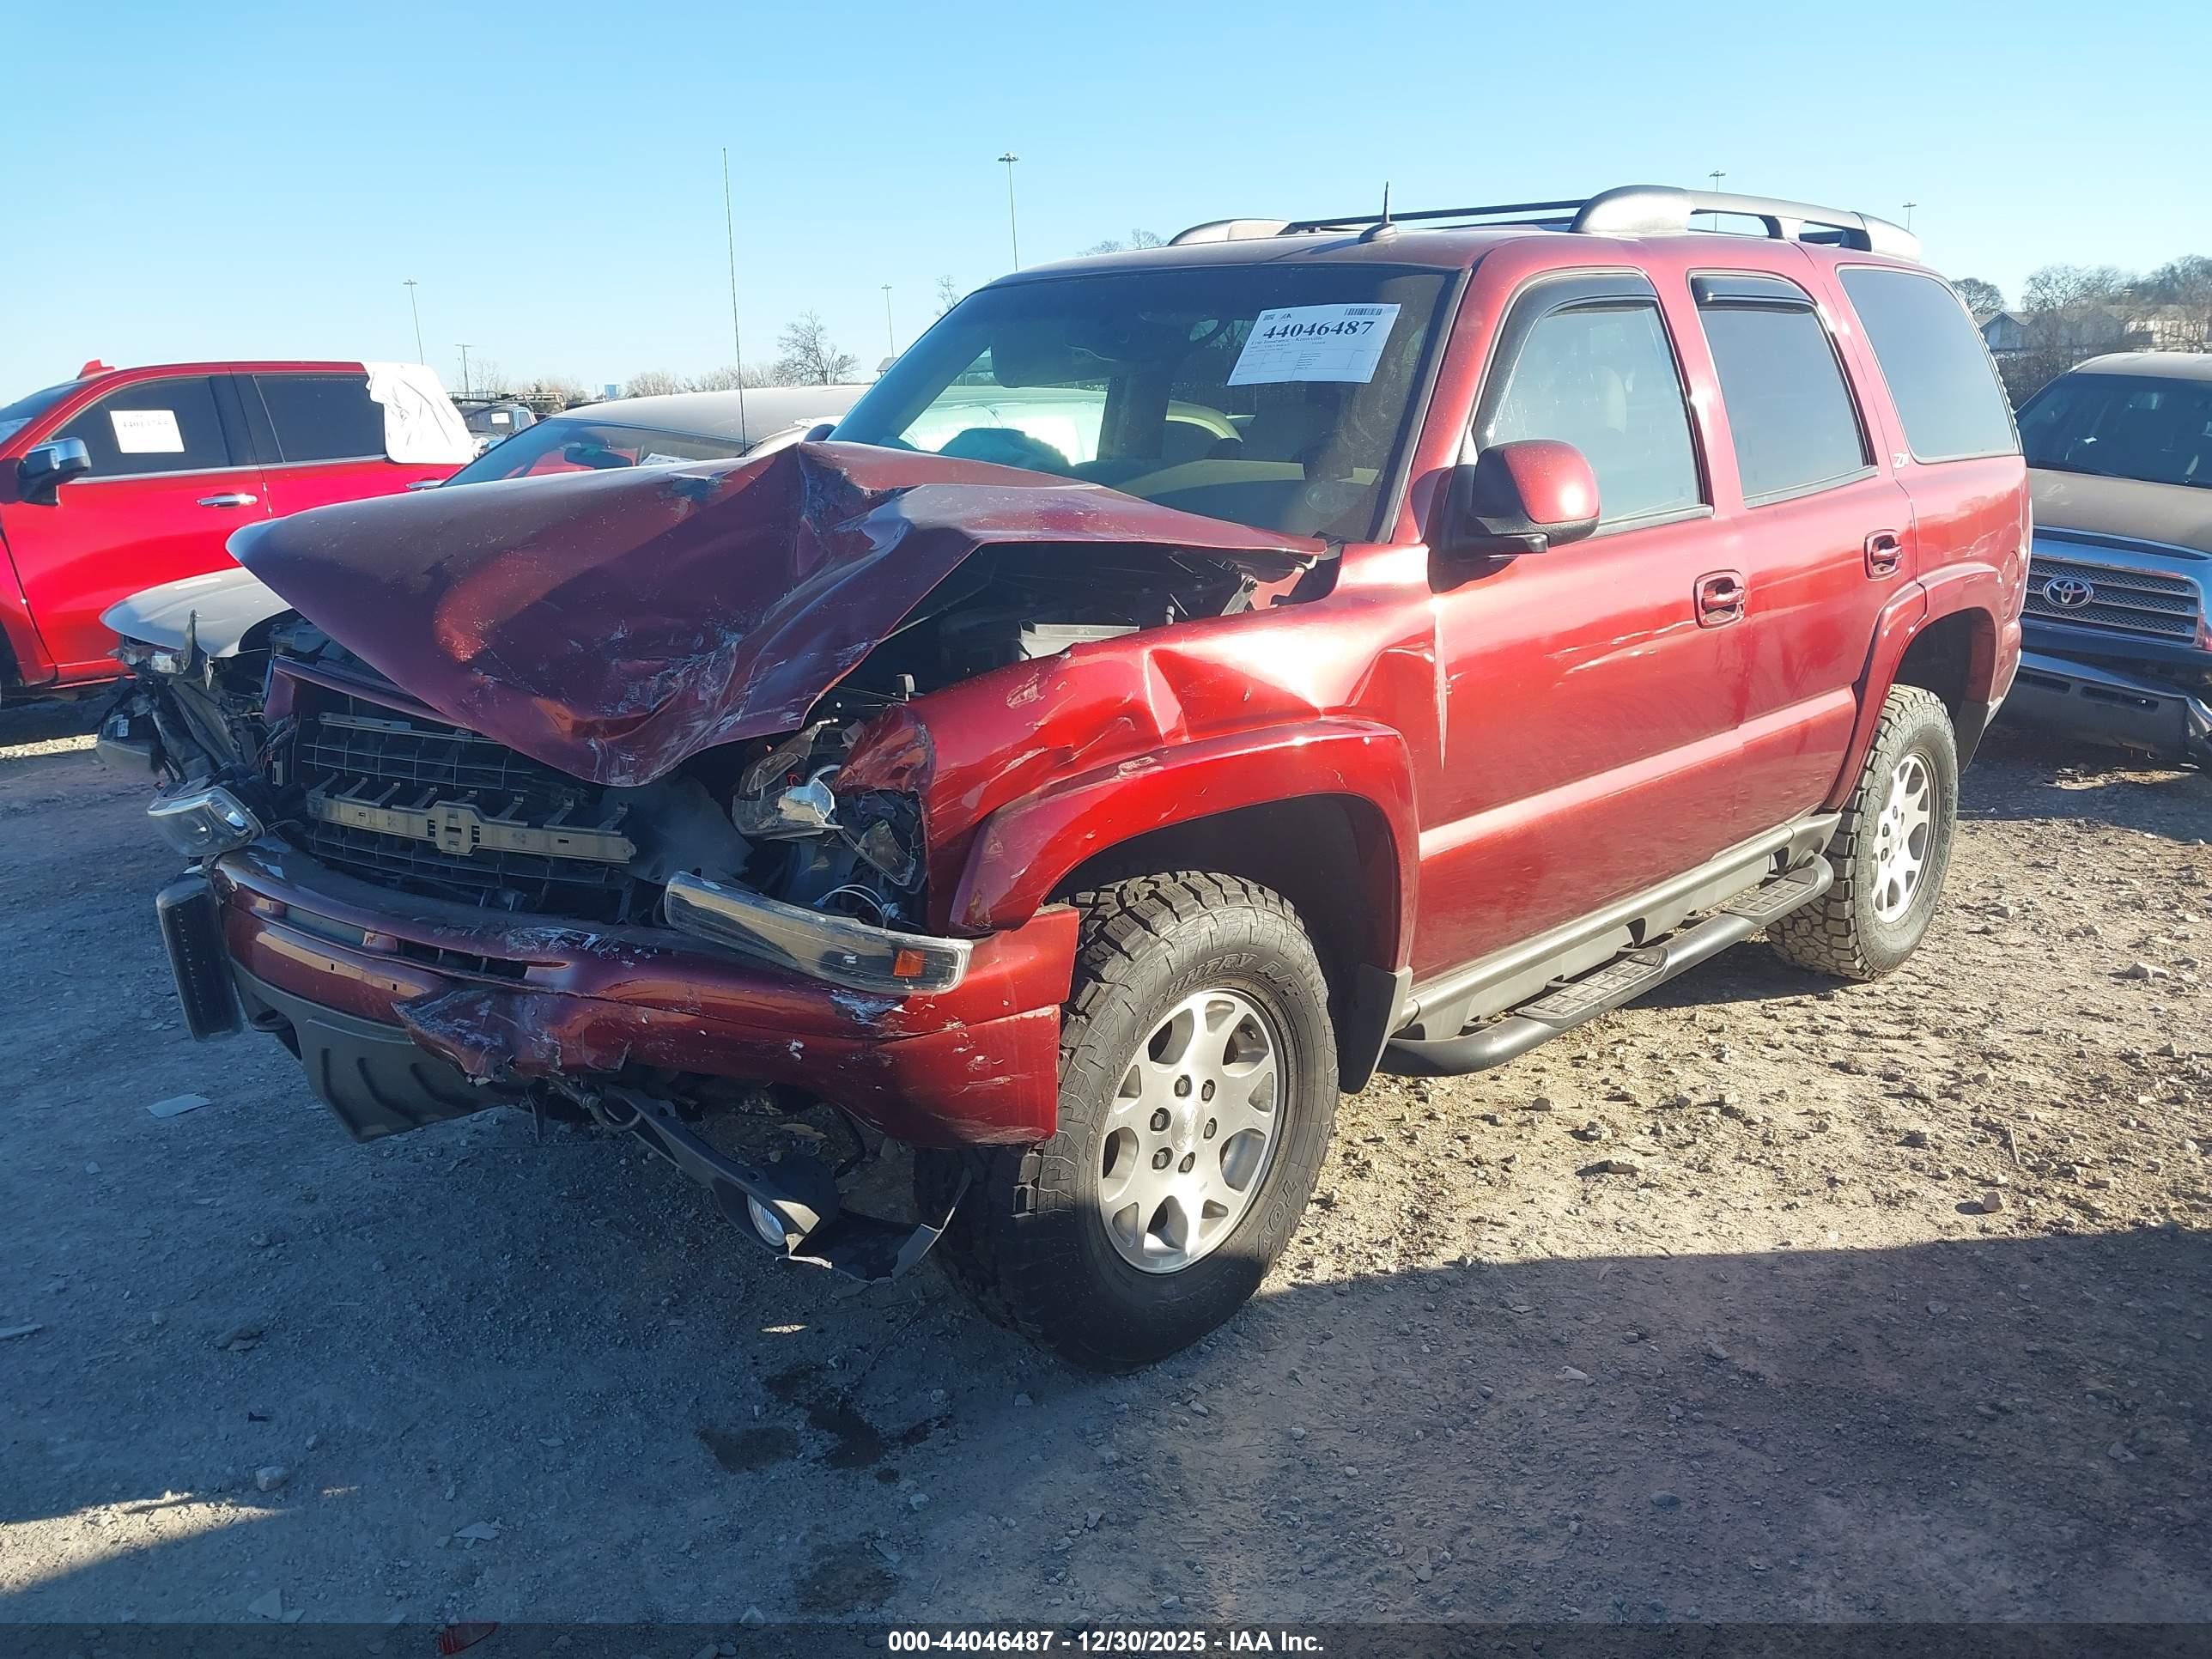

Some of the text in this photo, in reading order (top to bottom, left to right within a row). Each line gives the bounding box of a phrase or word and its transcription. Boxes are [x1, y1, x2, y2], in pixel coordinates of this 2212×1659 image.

[1263, 321, 1375, 339] 44046487
[1942, 782, 1954, 846] TOYO
[1132, 953, 1259, 1042] COUNTRY
[1255, 961, 1305, 998] A/T
